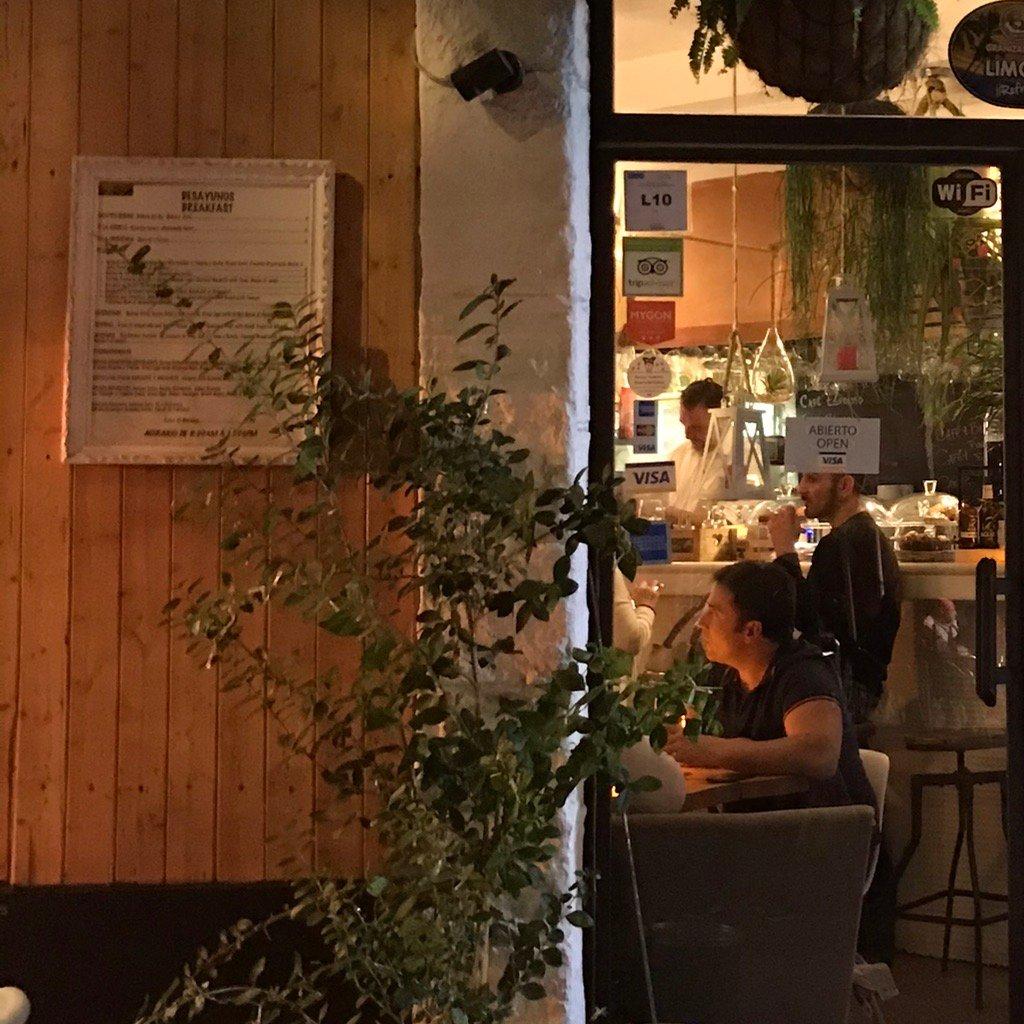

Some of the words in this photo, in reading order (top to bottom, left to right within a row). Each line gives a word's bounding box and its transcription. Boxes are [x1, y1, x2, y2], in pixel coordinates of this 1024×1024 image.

[641, 193, 672, 206] L10
[808, 424, 858, 437] ABIERTO
[816, 438, 849, 450] OPEN
[822, 456, 843, 465] VISA
[633, 470, 671, 485] VISA
